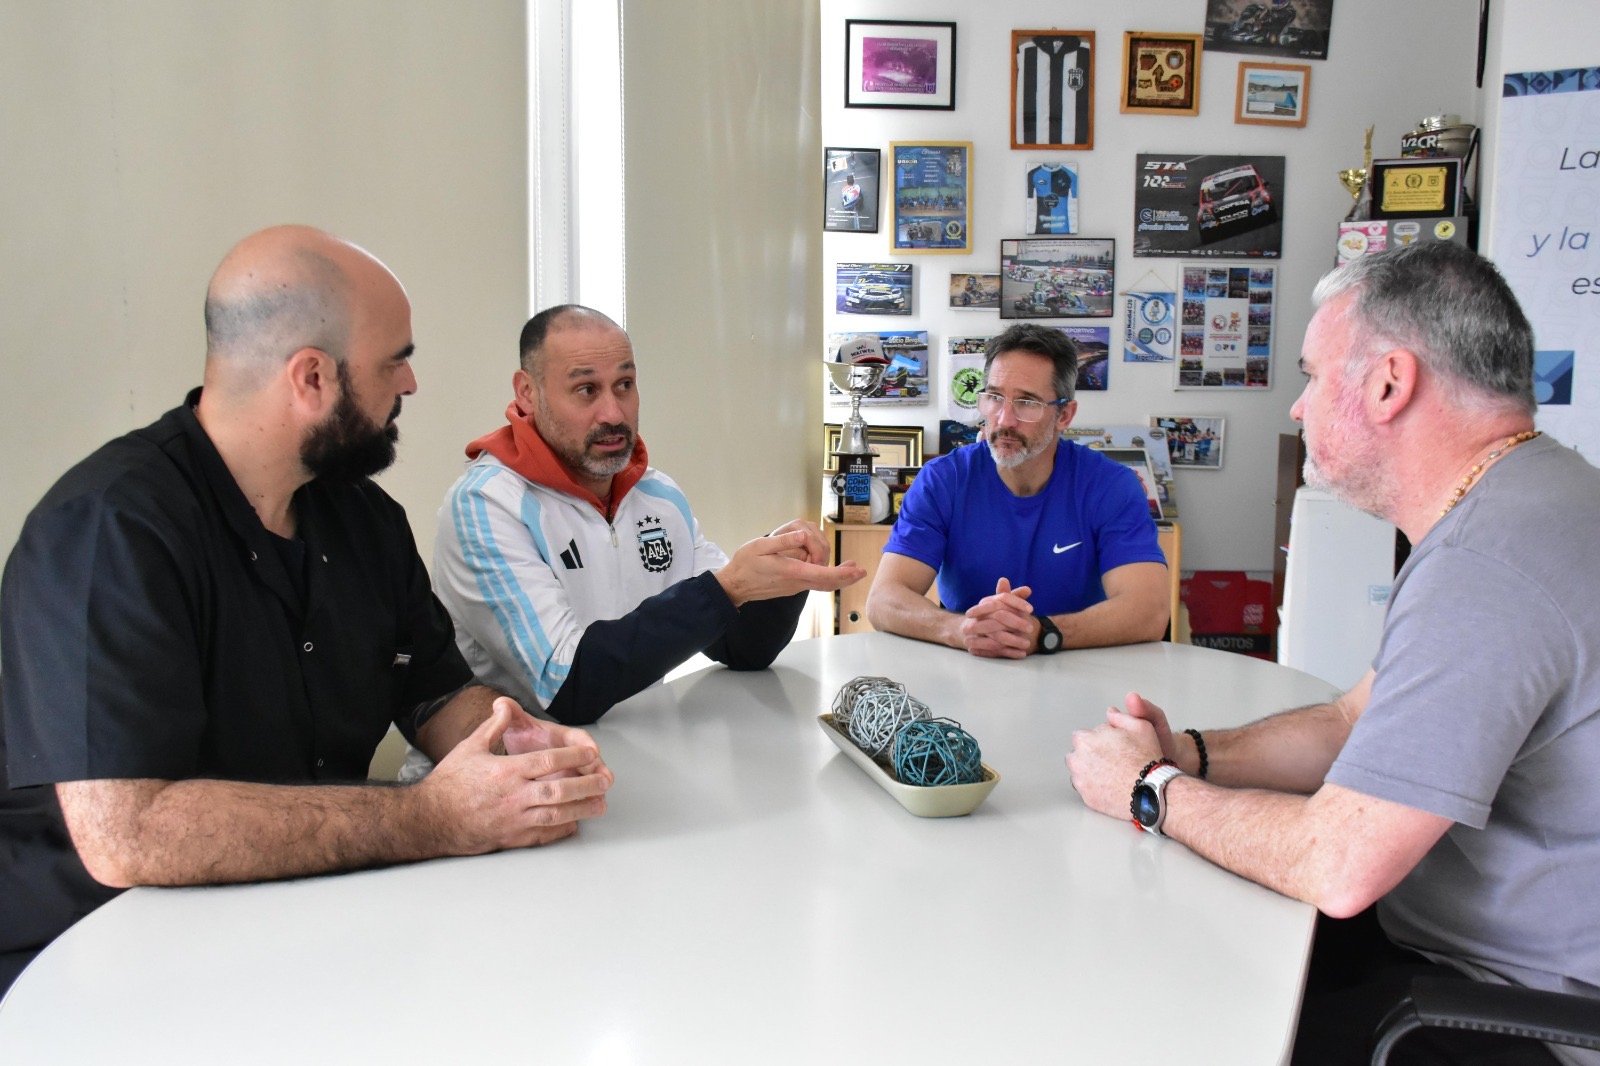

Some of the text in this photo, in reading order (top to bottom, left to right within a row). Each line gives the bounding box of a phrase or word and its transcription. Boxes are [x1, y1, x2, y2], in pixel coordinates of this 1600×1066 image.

[1143, 161, 1187, 171] STA
[1559, 147, 1600, 171] La
[1526, 226, 1590, 258] y la
[894, 264, 910, 272] 77
[1571, 277, 1600, 295] es
[648, 540, 668, 560] AFA
[1209, 636, 1255, 650] MOTOS
